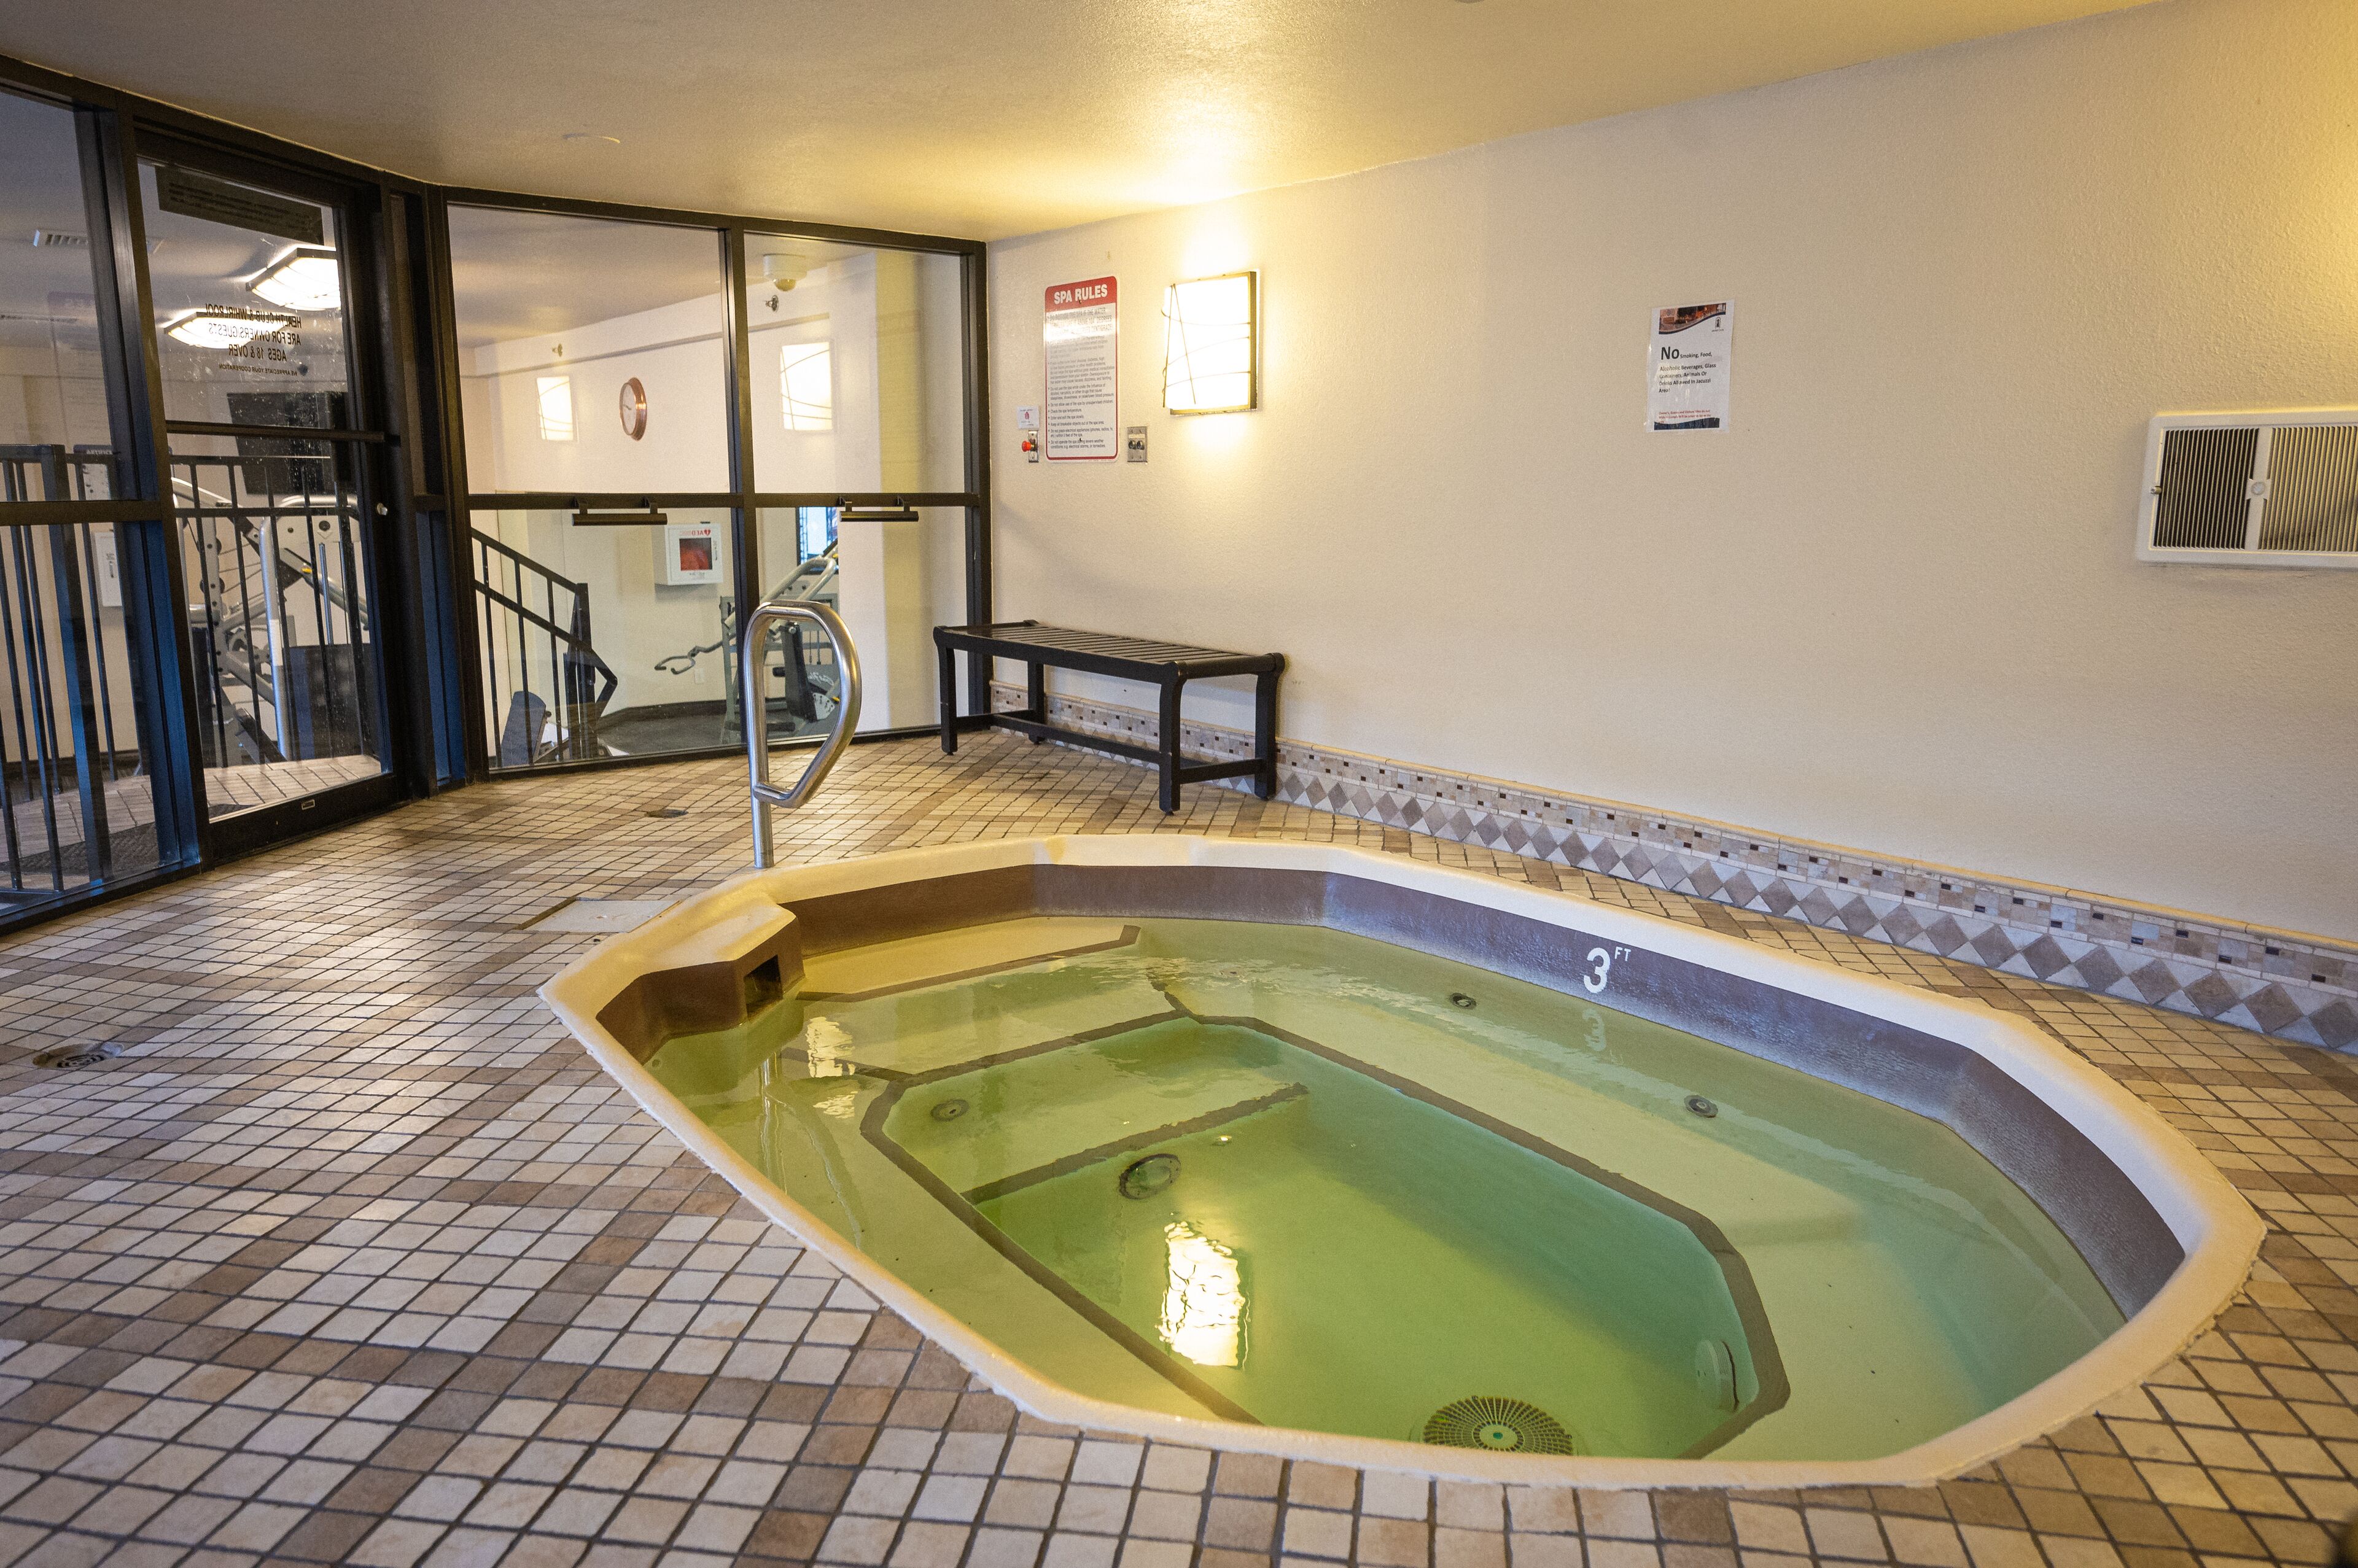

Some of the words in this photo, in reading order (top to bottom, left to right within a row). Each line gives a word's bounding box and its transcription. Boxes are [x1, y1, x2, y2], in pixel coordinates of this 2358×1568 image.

[1054, 290, 1073, 305] SPA
[1075, 284, 1108, 301] RULES
[1660, 346, 1679, 360] No
[1584, 947, 1611, 994] 3
[1614, 946, 1632, 961] FT
